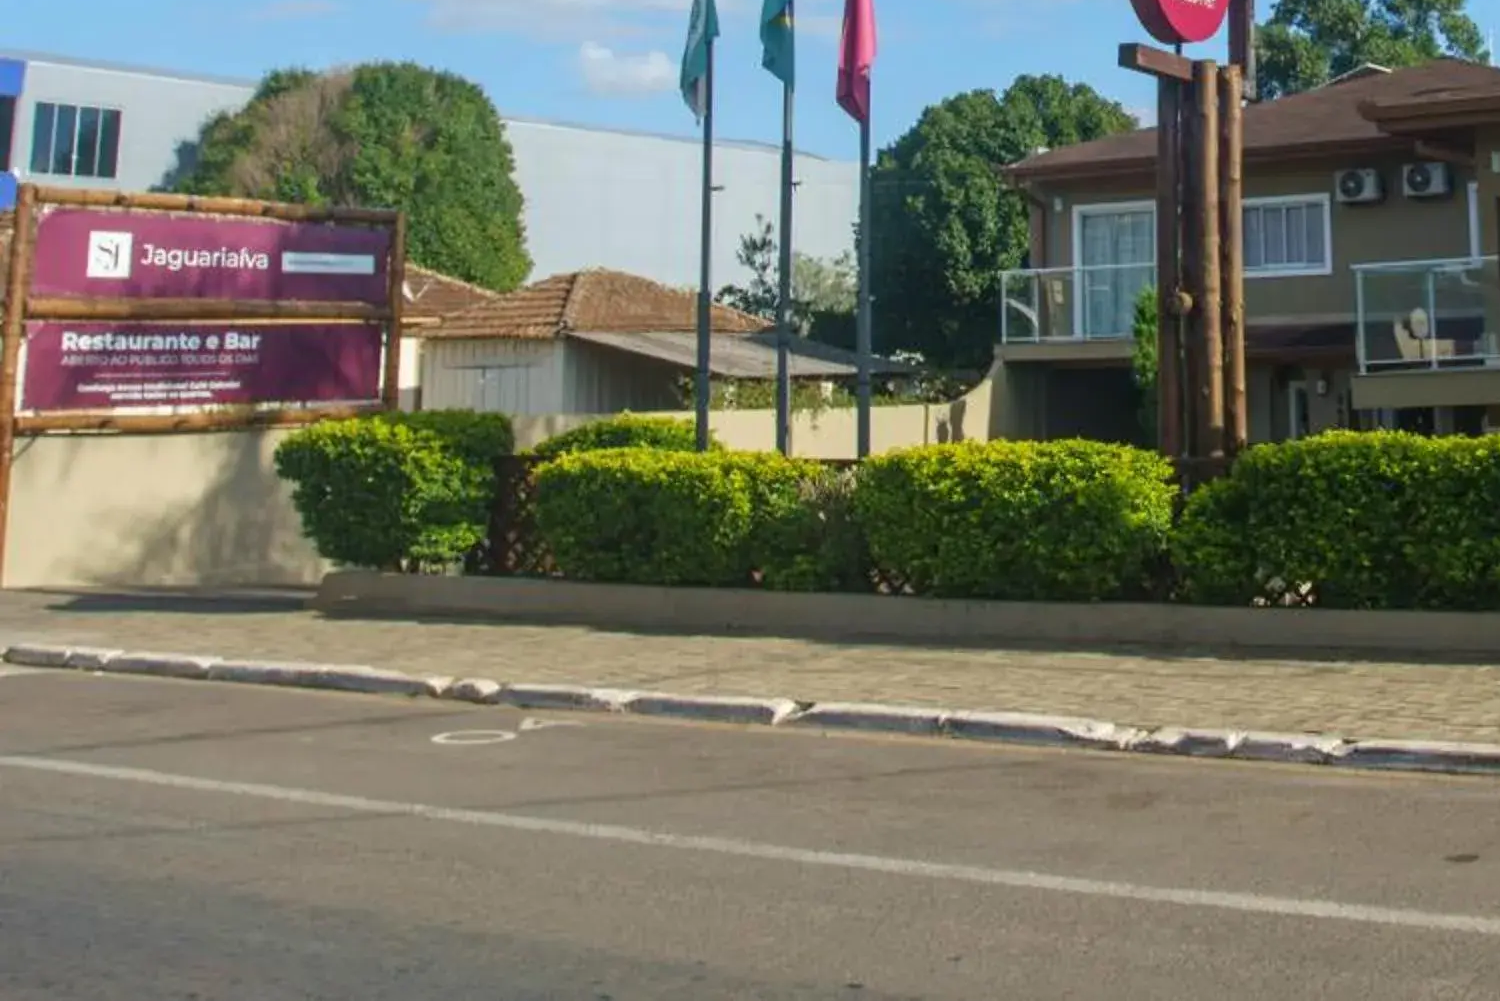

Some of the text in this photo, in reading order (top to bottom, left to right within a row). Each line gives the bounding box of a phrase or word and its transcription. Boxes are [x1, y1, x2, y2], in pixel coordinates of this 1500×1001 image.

[61, 332, 261, 350] Restaurante e Bar
